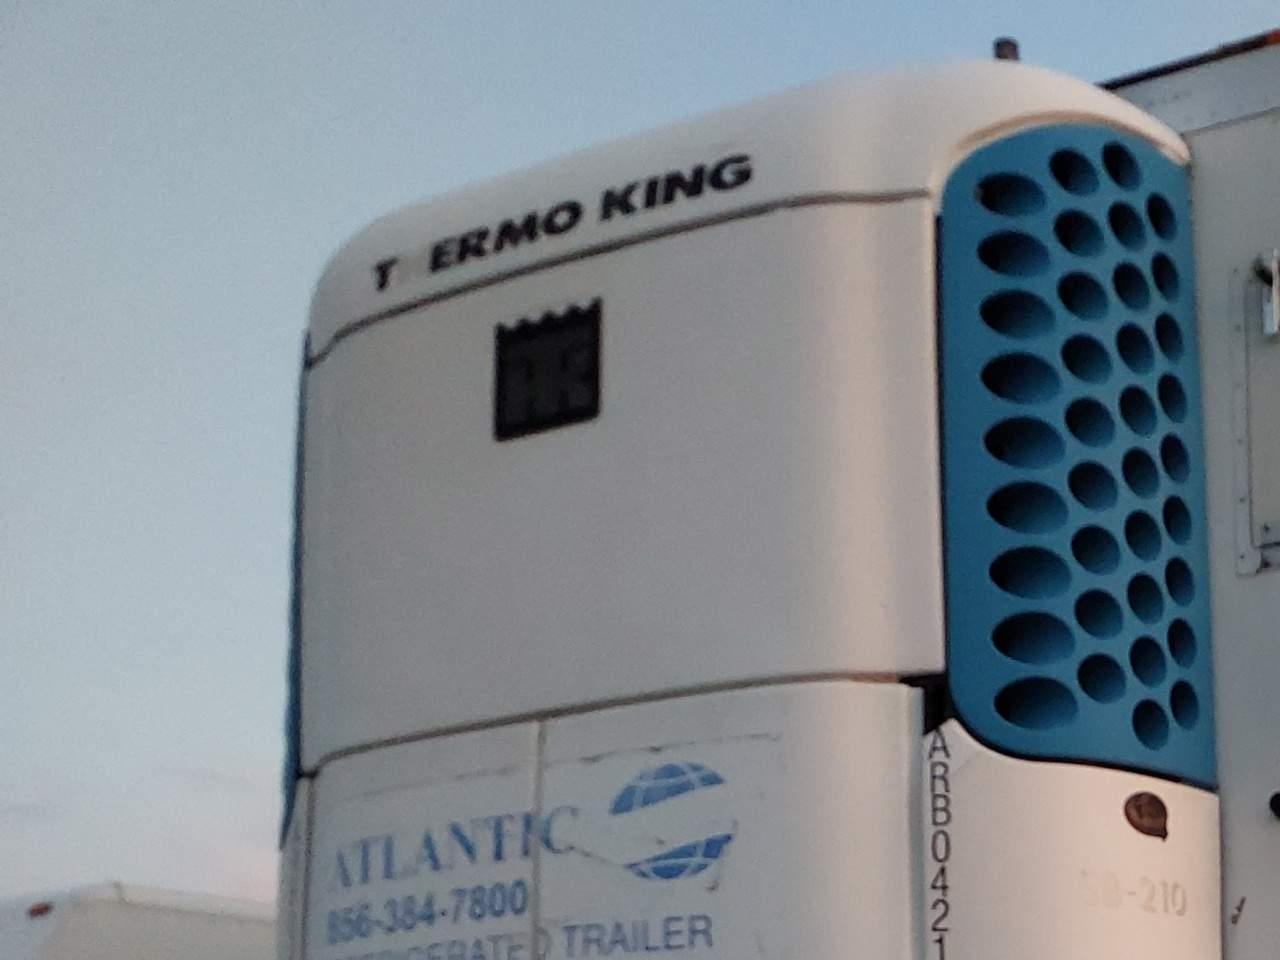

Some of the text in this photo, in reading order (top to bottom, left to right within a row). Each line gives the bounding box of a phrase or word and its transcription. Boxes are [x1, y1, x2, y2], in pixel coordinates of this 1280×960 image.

[374, 154, 752, 284] TERMO KING
[331, 804, 580, 889] ATLANTIC
[562, 913, 714, 958] TRAILER
